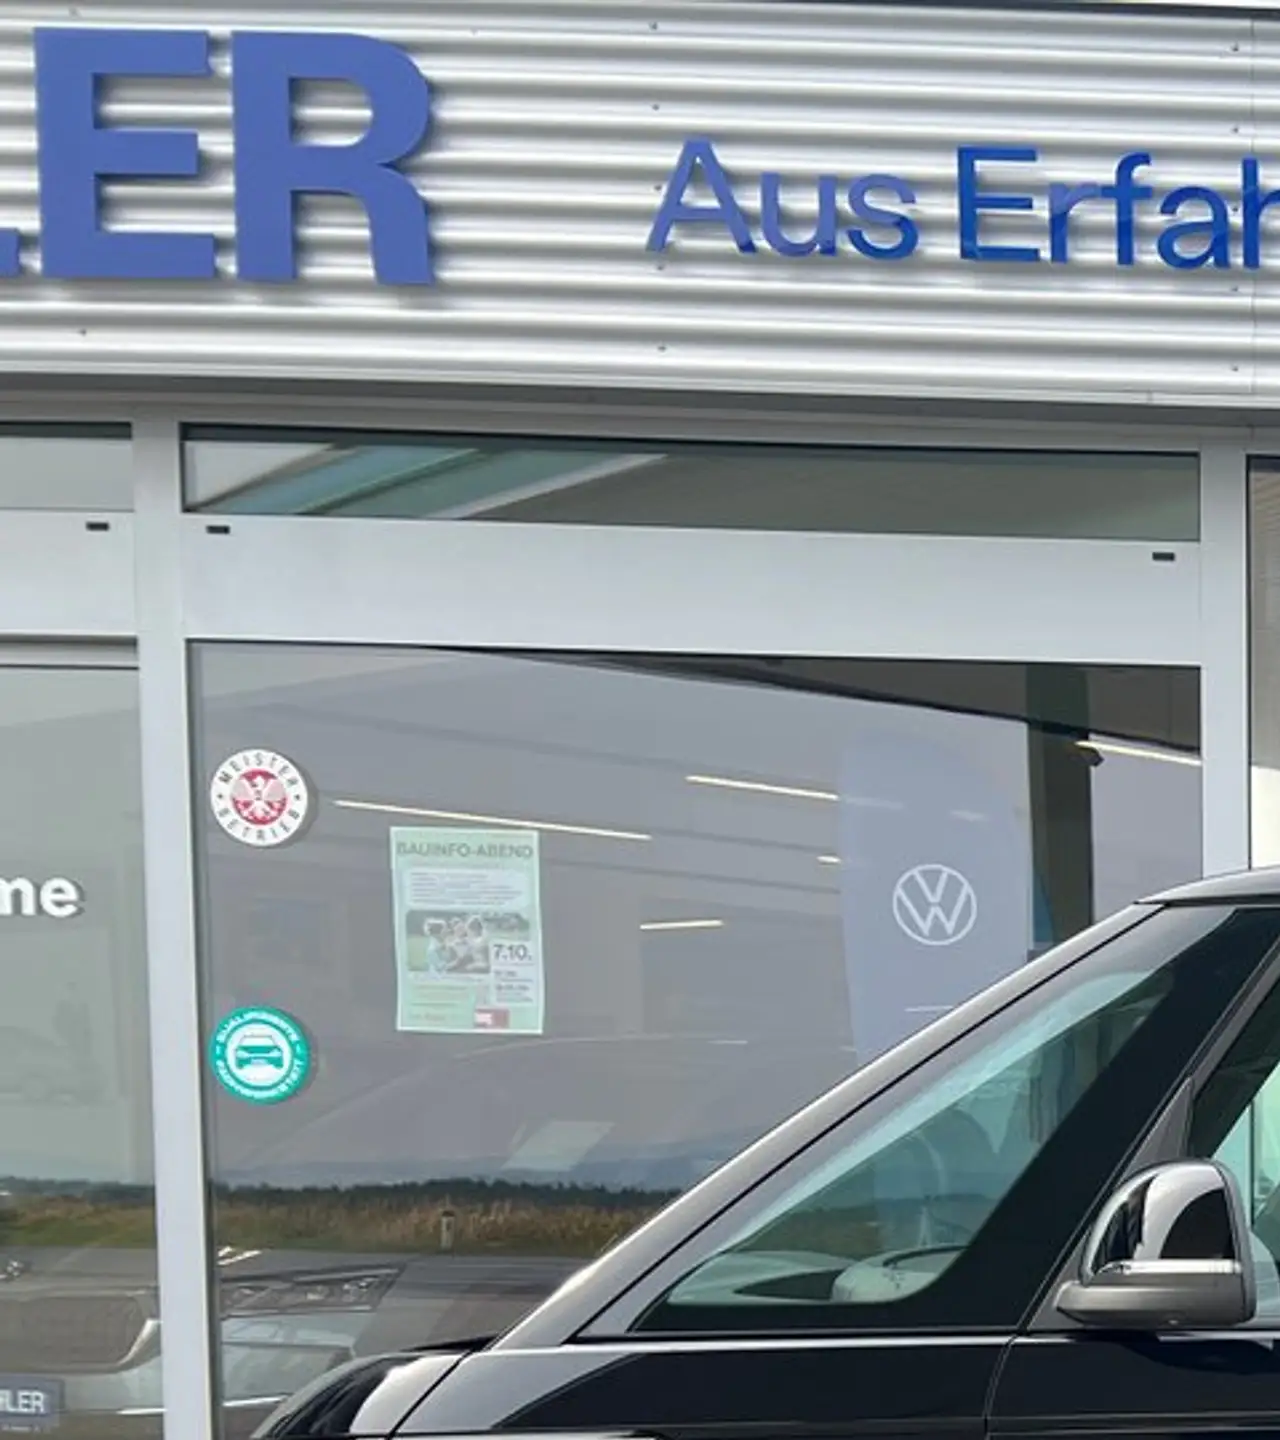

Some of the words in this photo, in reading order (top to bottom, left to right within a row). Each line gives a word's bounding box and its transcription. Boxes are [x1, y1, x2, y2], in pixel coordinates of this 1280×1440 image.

[0, 28, 437, 286] ER
[645, 138, 920, 260] Aus
[218, 752, 299, 788] MEISTER
[218, 807, 300, 841] BETRIEB
[493, 944, 533, 962] 7.10.
